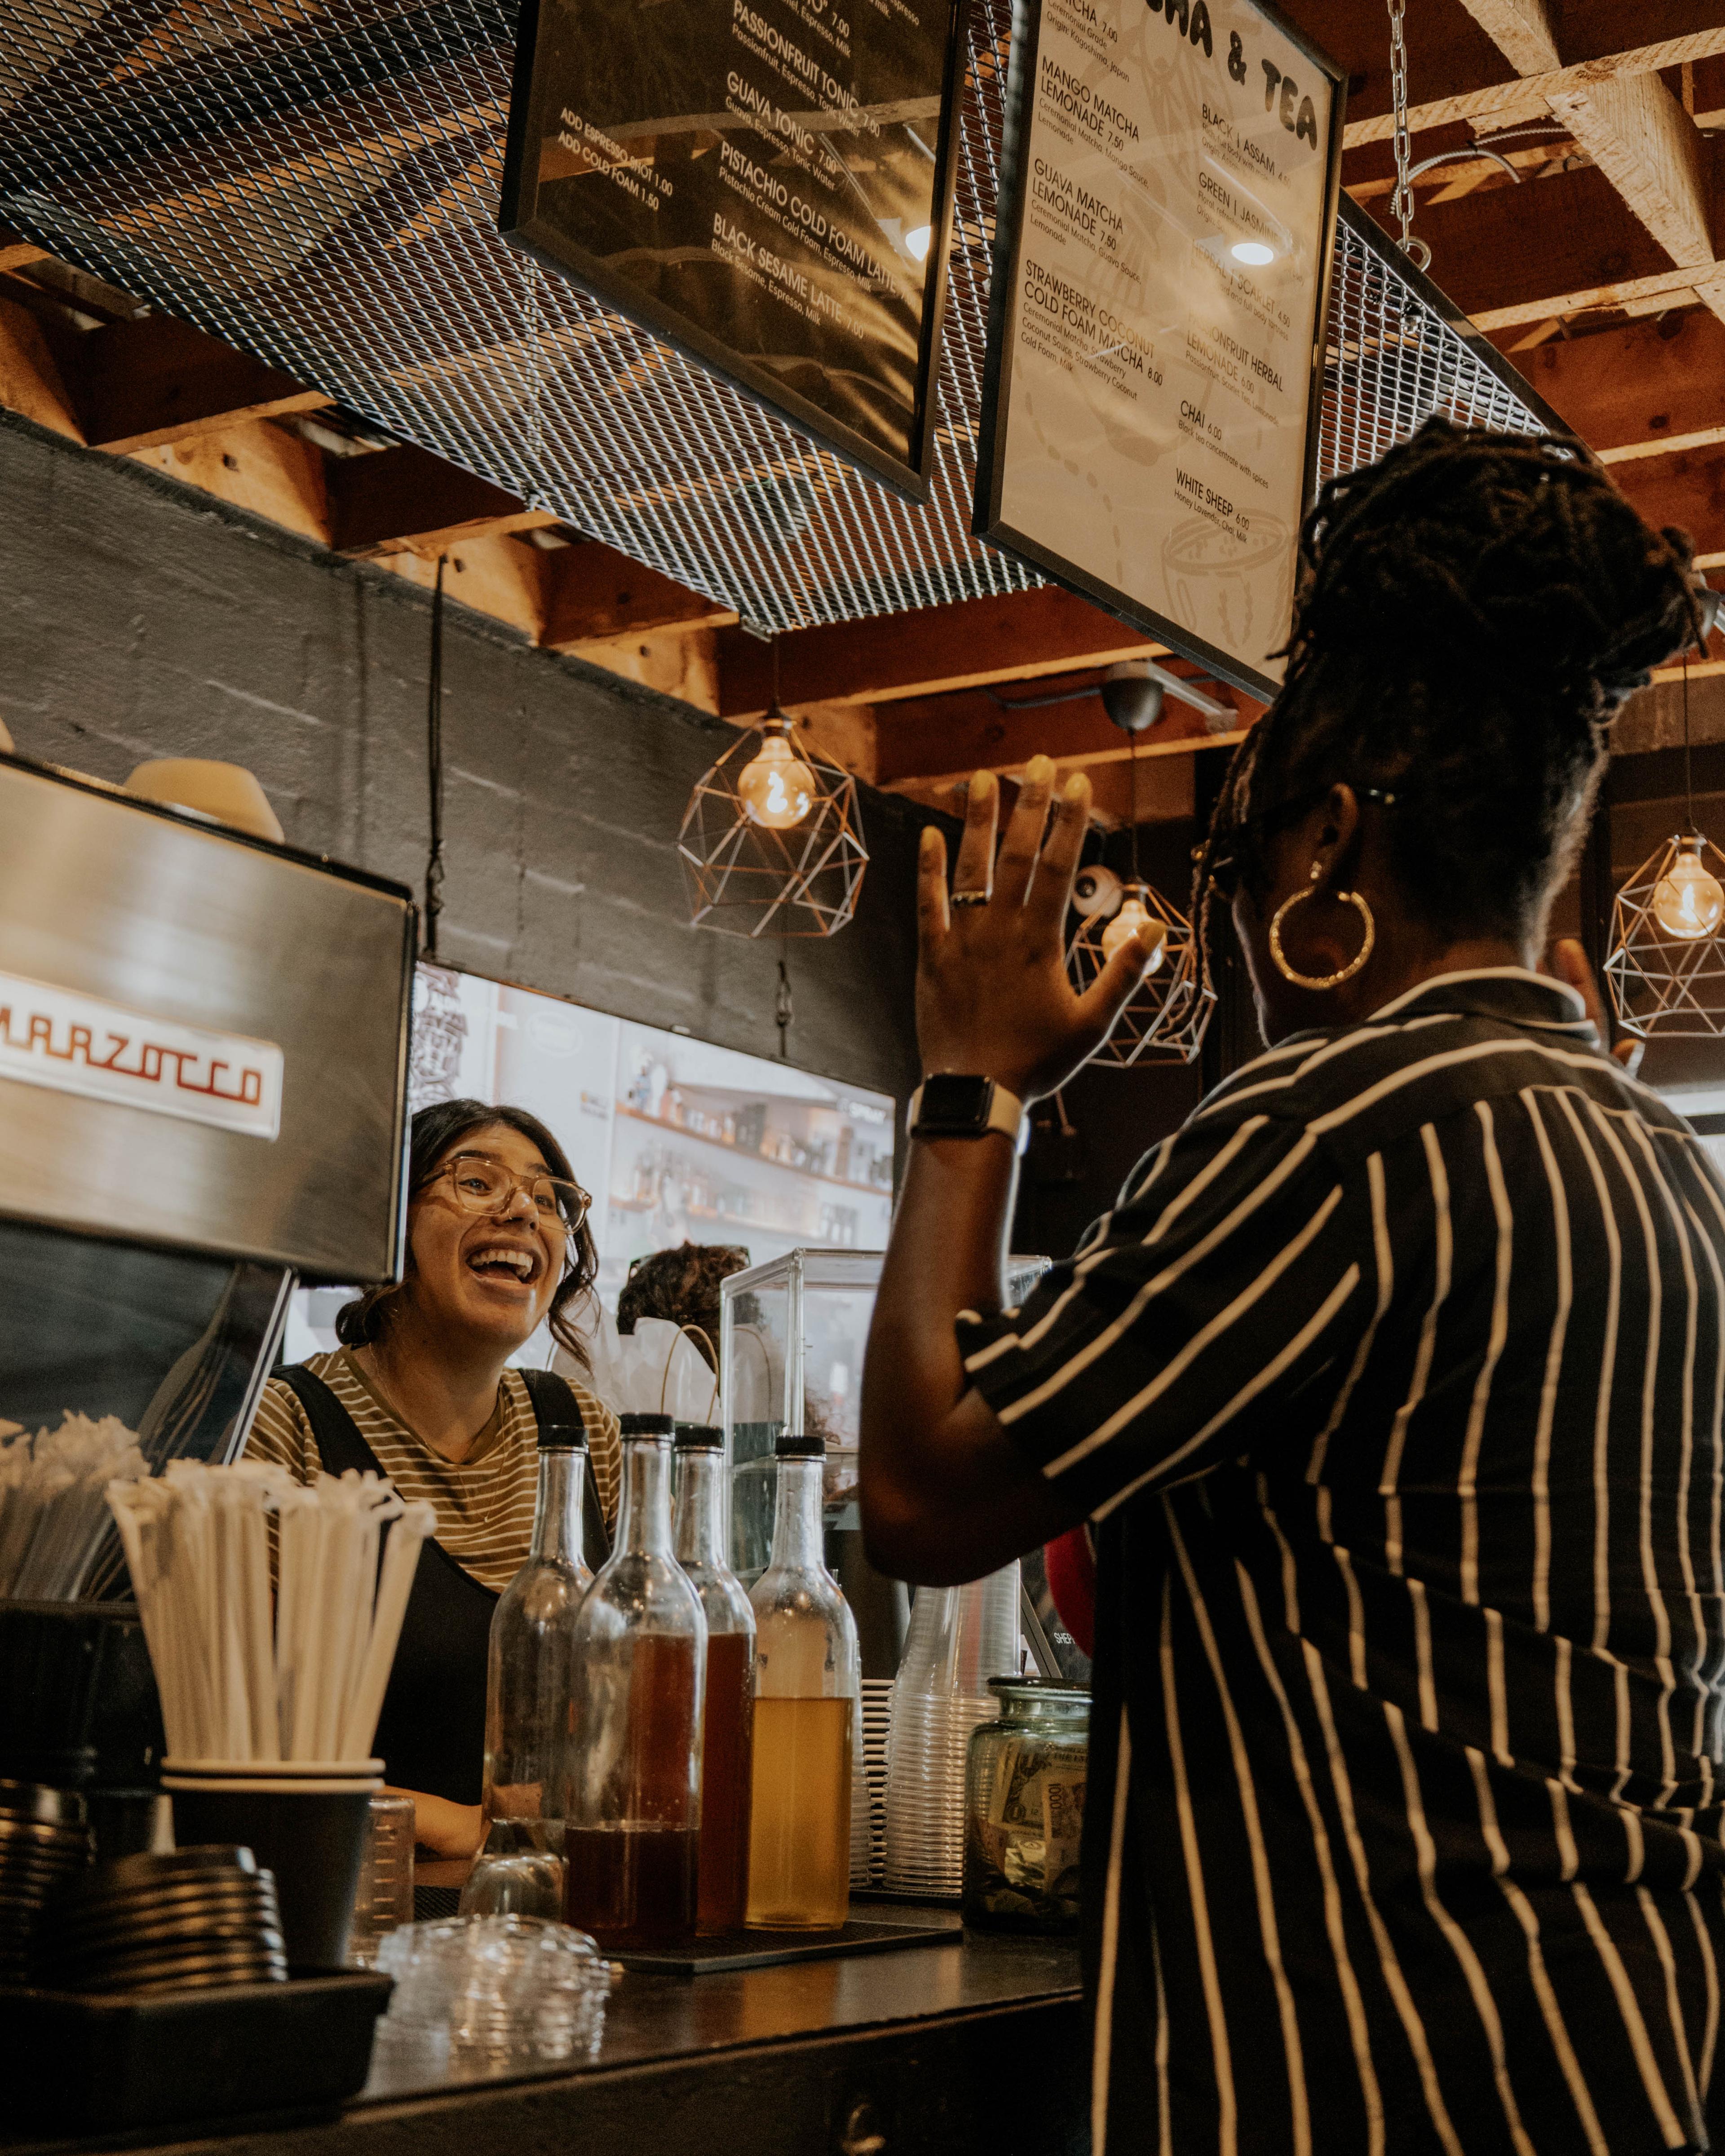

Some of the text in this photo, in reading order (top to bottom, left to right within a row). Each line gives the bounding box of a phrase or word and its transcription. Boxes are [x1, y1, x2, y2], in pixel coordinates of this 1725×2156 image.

[801, 5, 835, 45] Espresso,
[836, 36, 851, 58] Milk
[832, 12, 849, 38] 7.00
[1047, 11, 1129, 82] Origin: Kagoshima, Japan
[1088, 27, 1107, 49] Grade
[1102, 21, 1118, 42] 7.00
[732, 22, 779, 72] Passionfruit,
[782, 64, 815, 103] Espresso,
[818, 94, 837, 119] Tonic
[733, 0, 880, 137] PASSIONFRUIT TONIC 7.00
[1042, 55, 1140, 142] MANGO MATCHA
[1228, 30, 1247, 86] &
[1261, 59, 1318, 150] TEA
[726, 95, 835, 191] Guava, Espresso, Tonic Water
[727, 69, 836, 174] GUAVA TONIC 7.00
[1038, 112, 1073, 145] Lemonade
[1039, 97, 1149, 190] Ceremonial Matcha, Mango Sauce,
[1040, 75, 1123, 151] LEMONADE 7.50
[1202, 103, 1233, 140] BLACK
[1244, 138, 1275, 175] ASSAM
[558, 127, 658, 212] ADD COLD FOAM 1.50
[561, 104, 583, 133] ADD
[584, 122, 628, 165] ESPRESSO
[655, 172, 672, 197] 1.00
[1227, 143, 1241, 163] body
[721, 140, 787, 208] PISTACHIO
[791, 195, 827, 239] COLD
[829, 225, 865, 269] FOAM
[867, 255, 897, 293] LATTE
[1033, 177, 1115, 251] LEMONADE 7.50
[1035, 157, 1123, 234] GUAVA MATCHA
[1199, 172, 1230, 207] GREEN
[719, 165, 754, 203] Pistachio
[757, 194, 780, 223] Cream
[783, 215, 798, 236] Cold
[800, 228, 821, 256] Foam,
[857, 273, 871, 292] Milk
[1030, 212, 1066, 246] Lemonade
[1032, 199, 1069, 233] Ceremonial
[1071, 226, 1096, 254] Matcha,
[1099, 247, 1119, 268] Guava
[712, 238, 734, 263] Black
[769, 279, 803, 315] Espresso,
[805, 306, 821, 326] Milk
[713, 212, 756, 260] BLACK
[759, 247, 808, 298] SESAME
[811, 285, 842, 323] LATTE
[1238, 274, 1274, 314] SCARLET
[1278, 310, 1290, 327] 4.50
[1024, 302, 1062, 334] Ceremonial
[1025, 280, 1162, 386] COLD FOAM MATCHA 8.00
[1026, 259, 1154, 358] STRAWBERRY COCONUT
[1254, 307, 1266, 325] body
[1022, 331, 1074, 373] Cold Foam, Milk
[1022, 316, 1137, 400] Coconut Sauce, Strawberry Coconut
[1187, 330, 1253, 393] LEMONADE 6.00
[1189, 309, 1283, 391] PONFRUIT HERBAL
[1179, 420, 1194, 437] Black
[1206, 441, 1237, 467] concentrate
[1240, 464, 1251, 476] with
[1252, 473, 1268, 488] spices
[1181, 399, 1221, 440] CHAI 6.00
[1174, 488, 1247, 543] Honey Lavender, Chai, Milk
[1176, 468, 1249, 530] WHITE SHEEP 6.00
